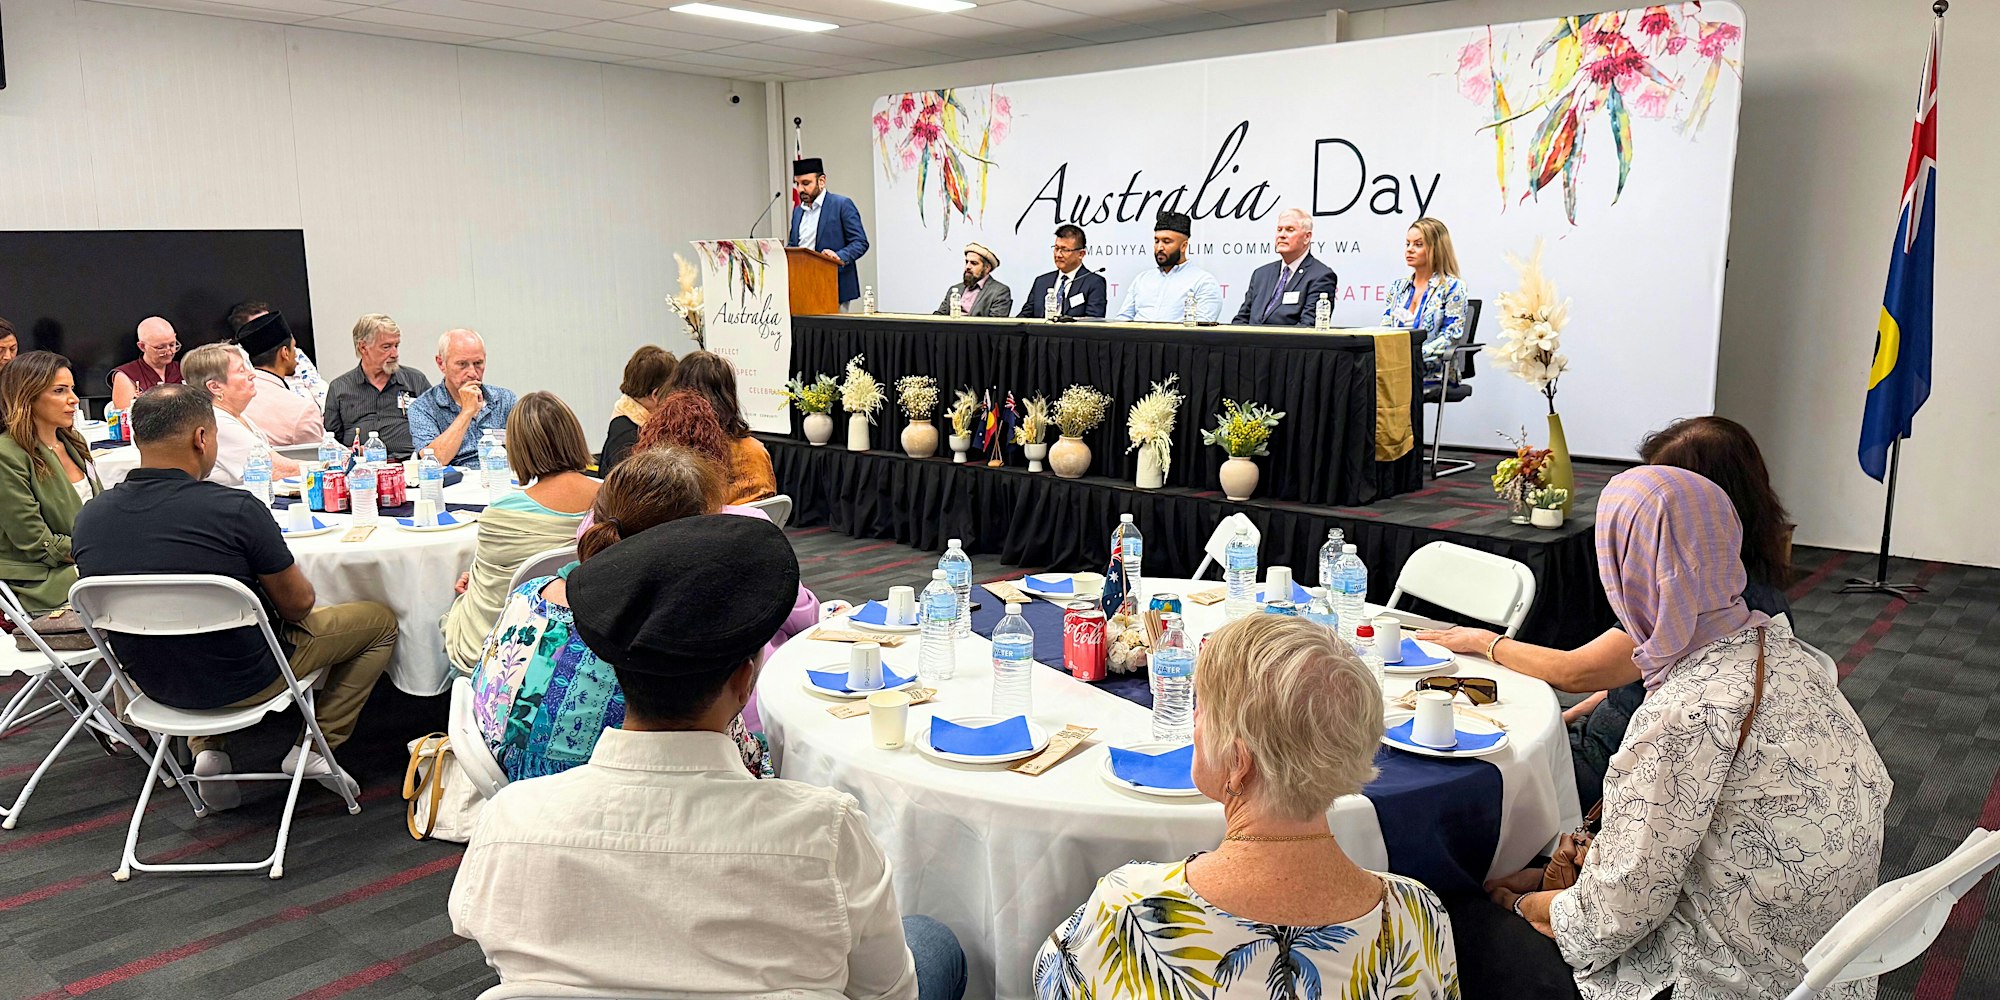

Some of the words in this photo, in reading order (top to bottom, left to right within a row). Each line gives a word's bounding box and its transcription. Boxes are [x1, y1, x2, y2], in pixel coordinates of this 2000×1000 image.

[1014, 120, 1280, 236] Australia
[1312, 138, 1441, 219] Day
[1085, 244, 1147, 256] MADIYYA
[1222, 240, 1326, 255] COMMTY
[1334, 240, 1361, 254] WA
[712, 293, 782, 326] Australia
[758, 324, 782, 352] Day
[714, 347, 739, 356] REFLECT
[736, 368, 757, 376] SPECT
[749, 387, 781, 396] CELEBRA
